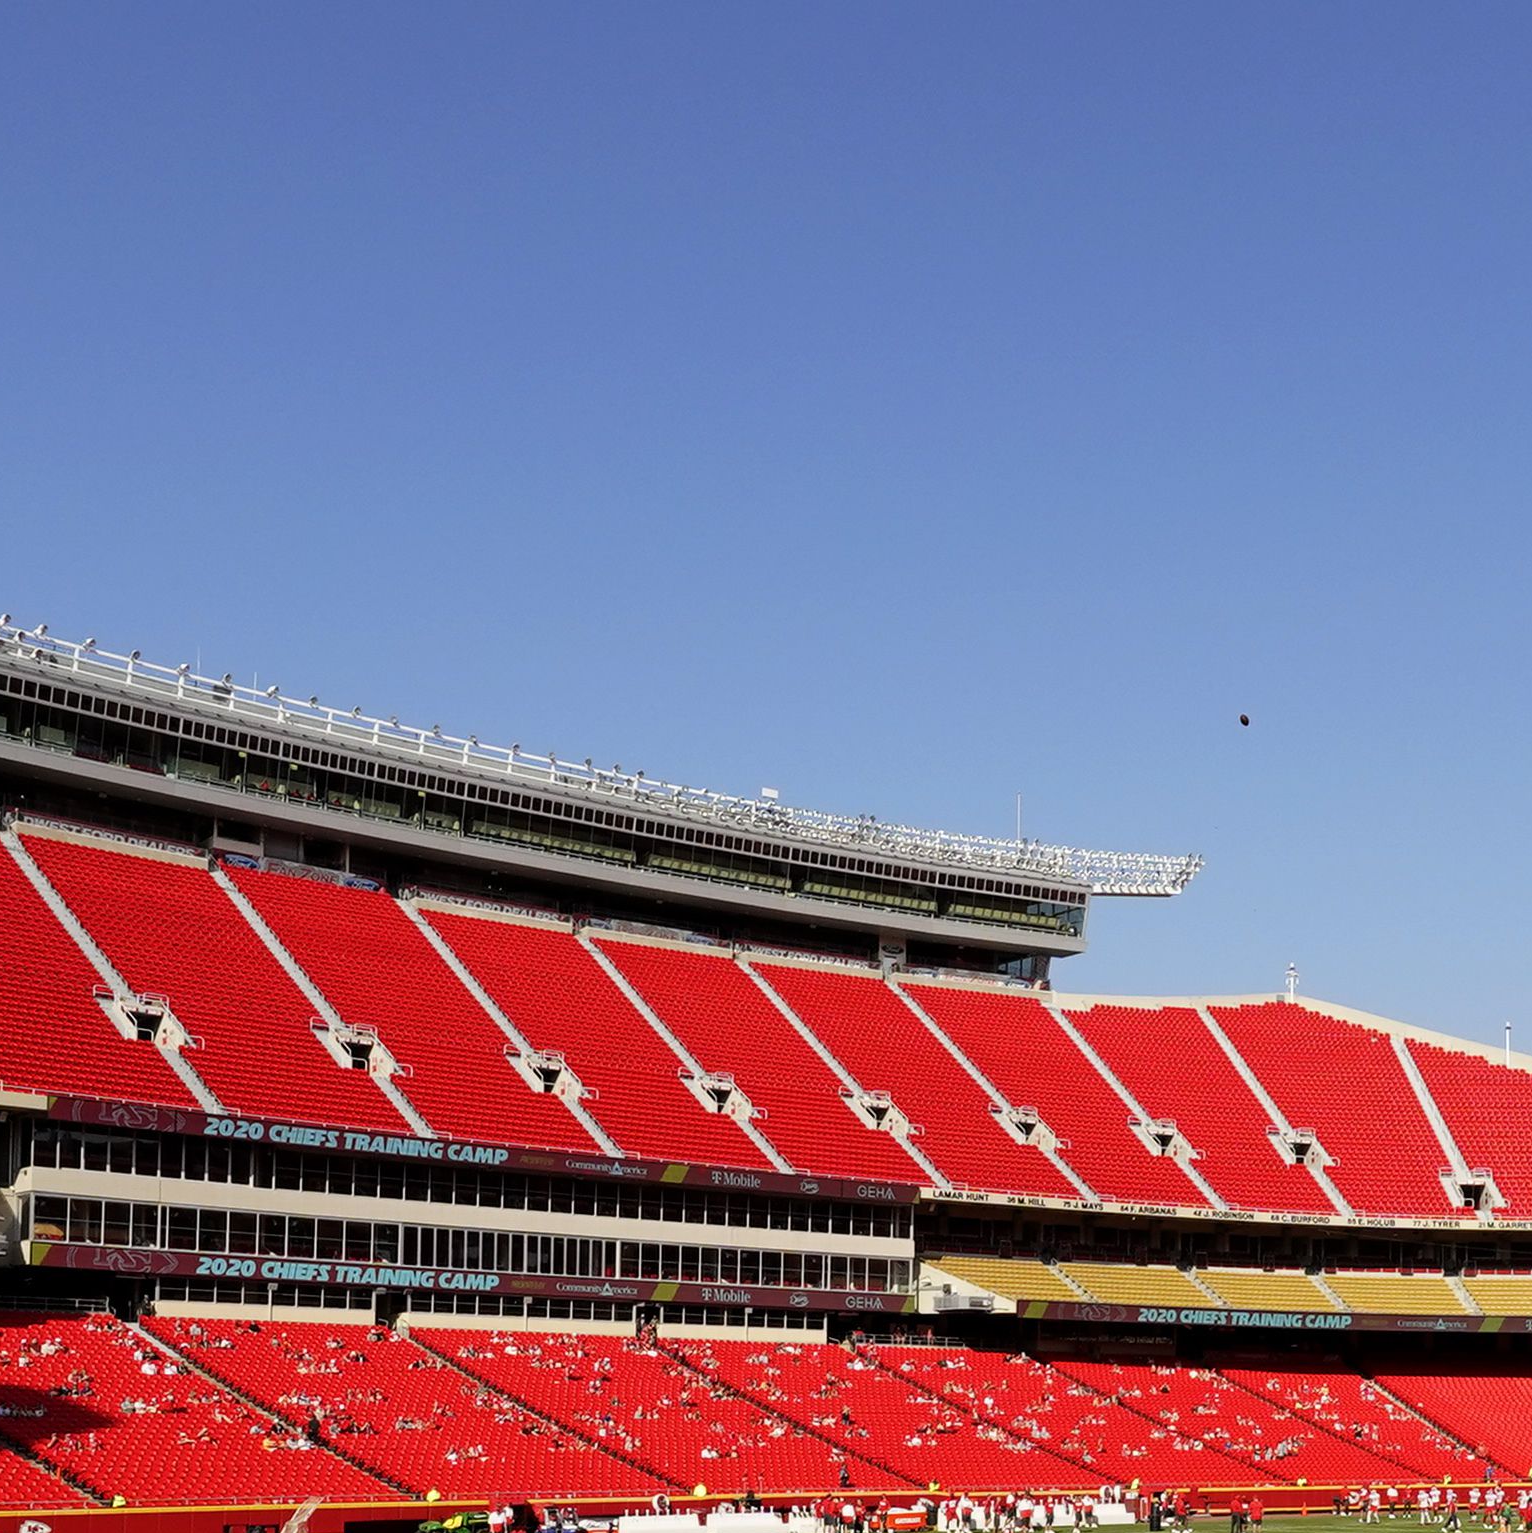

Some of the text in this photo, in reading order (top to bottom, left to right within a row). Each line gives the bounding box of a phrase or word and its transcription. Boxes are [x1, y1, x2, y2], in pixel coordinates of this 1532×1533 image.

[203, 1116, 265, 1140] 2020
[269, 1123, 339, 1148] CHIEFS
[343, 1132, 443, 1159] TRAINING
[447, 1144, 509, 1165] CAMP
[856, 1183, 895, 1200] GEHA
[932, 1190, 990, 1202] LAMAR HUNT
[1030, 1197, 1047, 1207] HILL
[1081, 1202, 1105, 1212] MAYS
[1139, 1207, 1178, 1217] ARBANAS
[1212, 1211, 1255, 1221] ROBINSON
[1290, 1215, 1331, 1225] BURFORD
[1366, 1218, 1396, 1228] HOLUB
[1431, 1220, 1461, 1229] TYRER
[196, 1256, 257, 1278] 2020
[261, 1261, 330, 1283] CHIEFS
[335, 1265, 435, 1288] TRAINING
[438, 1271, 500, 1291] CAMP
[845, 1295, 884, 1309] GEHA
[1138, 1308, 1176, 1323] 2020
[1180, 1310, 1228, 1326] CHIEFS
[1231, 1312, 1303, 1328] TRAINING
[1305, 1314, 1352, 1329] CAMP
